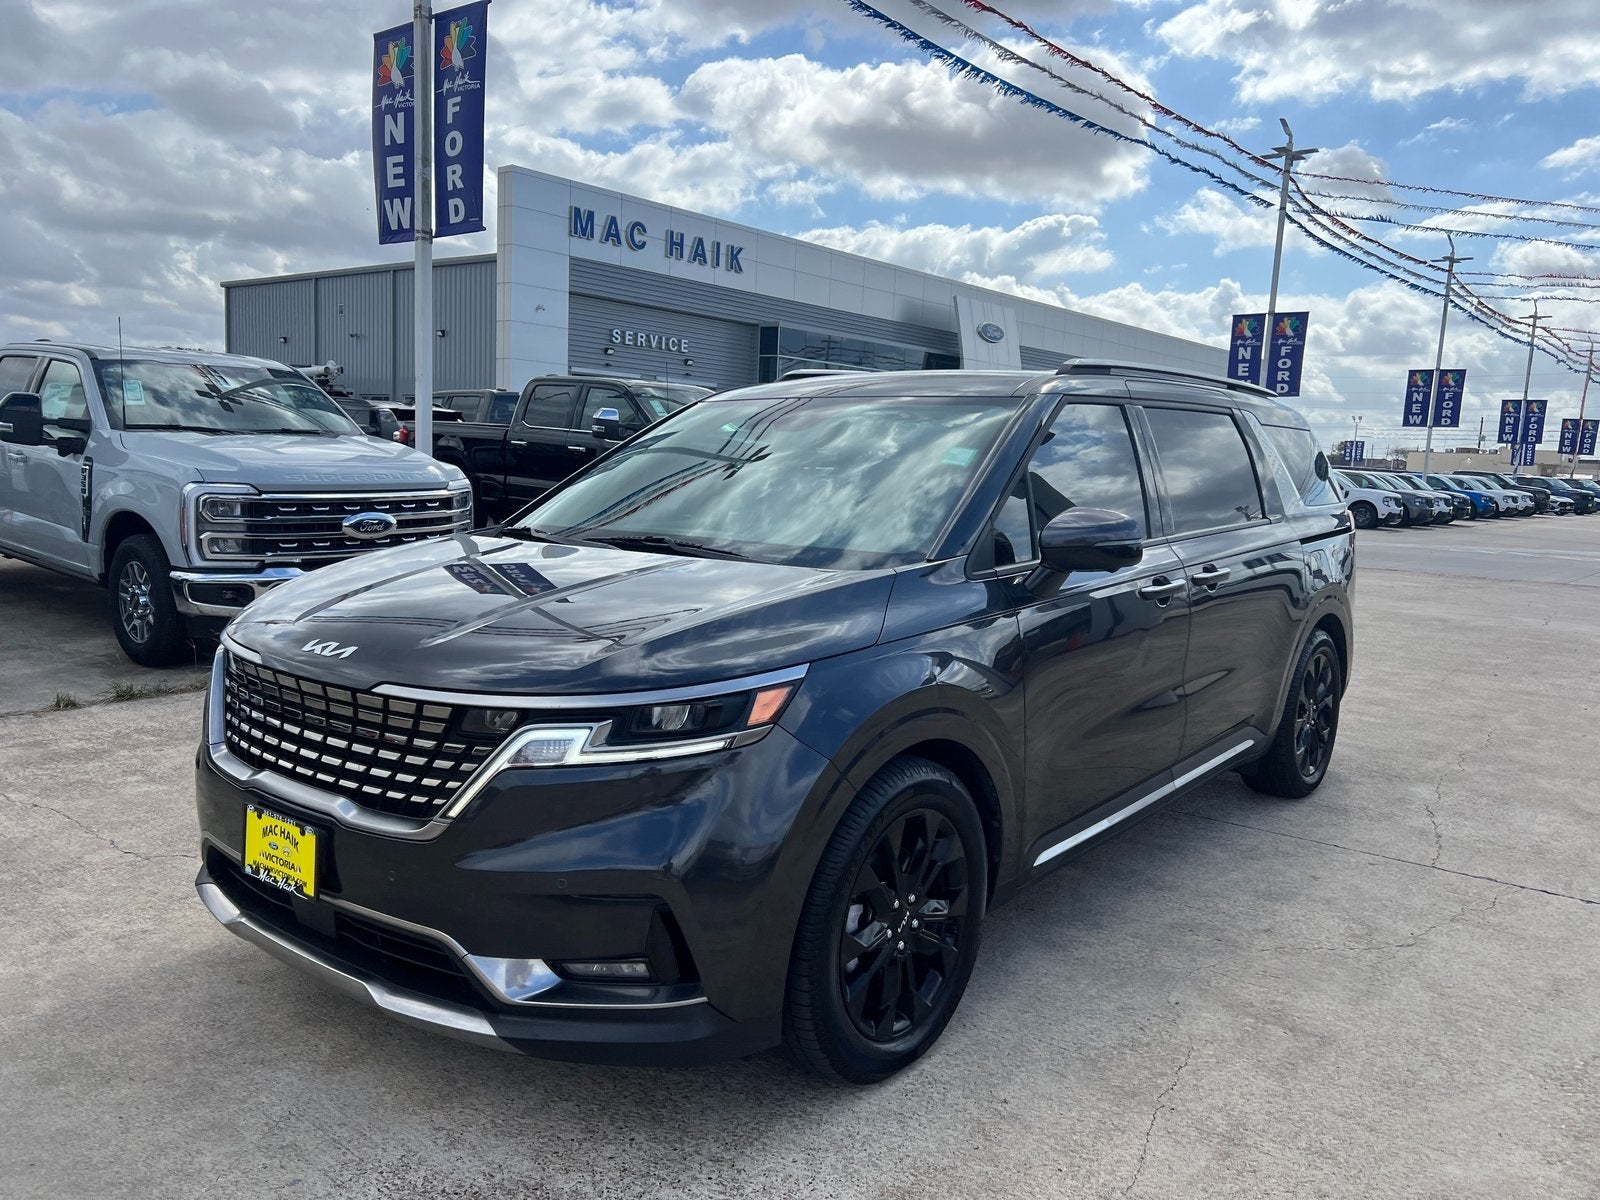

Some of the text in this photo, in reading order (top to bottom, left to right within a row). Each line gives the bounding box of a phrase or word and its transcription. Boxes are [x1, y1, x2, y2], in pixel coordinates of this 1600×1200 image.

[384, 111, 412, 231] NEW
[445, 96, 465, 224] FORD
[569, 206, 744, 274] MAC HAIK
[612, 329, 689, 353] SERVICE
[1237, 347, 1252, 383] NE
[1276, 346, 1292, 394] FORD
[1409, 392, 1424, 425] NEW
[1441, 392, 1454, 426] FORD
[1502, 417, 1514, 442] NEW
[1527, 417, 1538, 443] FORD
[1562, 432, 1572, 453] NEW
[1582, 433, 1592, 454] FORD
[359, 519, 386, 532] Ford
[262, 824, 279, 839] MAC
[279, 826, 300, 854] HAIK
[264, 851, 297, 872] VICTORIA
